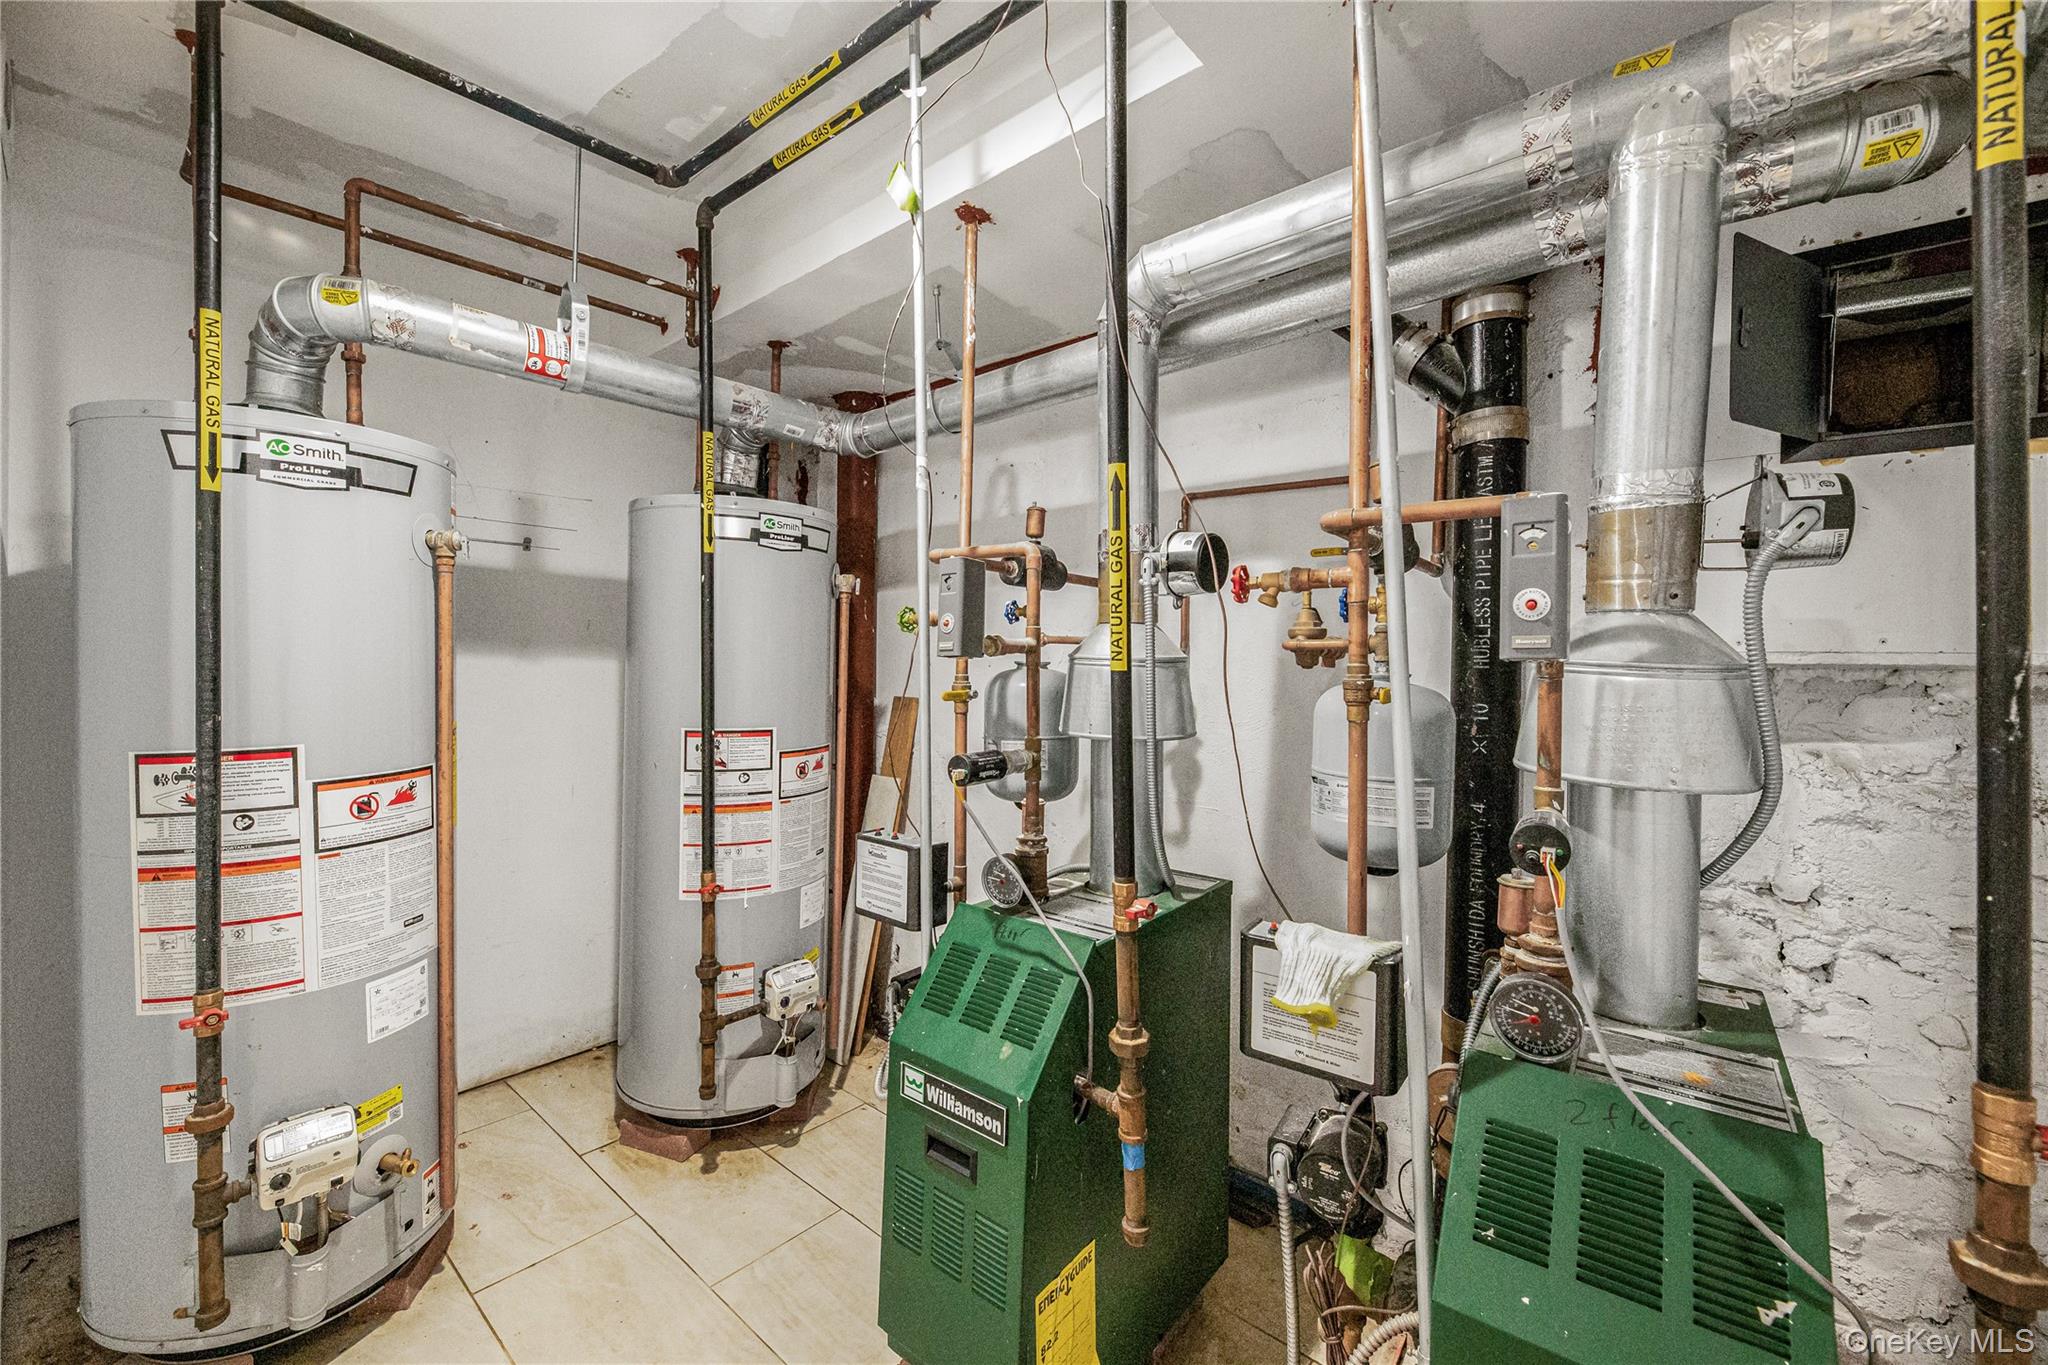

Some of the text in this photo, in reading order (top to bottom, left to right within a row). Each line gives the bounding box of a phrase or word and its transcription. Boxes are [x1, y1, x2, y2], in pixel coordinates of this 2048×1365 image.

[1983, 1, 2016, 150] NATURAL
[753, 77, 808, 123] NATURAL GAS
[776, 123, 830, 164] NATURAL GAS
[205, 317, 220, 428] NATURAL GAS
[280, 462, 331, 475] ProLine
[293, 444, 341, 461] Smith
[705, 437, 714, 511] NATURAL GAS
[1477, 455, 1493, 496] ASTM
[777, 521, 800, 531] Smith
[1474, 551, 1492, 588] PIPE
[1111, 535, 1123, 662] NATURAL GAS
[1474, 596, 1490, 670] HUBLESS
[926, 1083, 1002, 1136] Williamson
